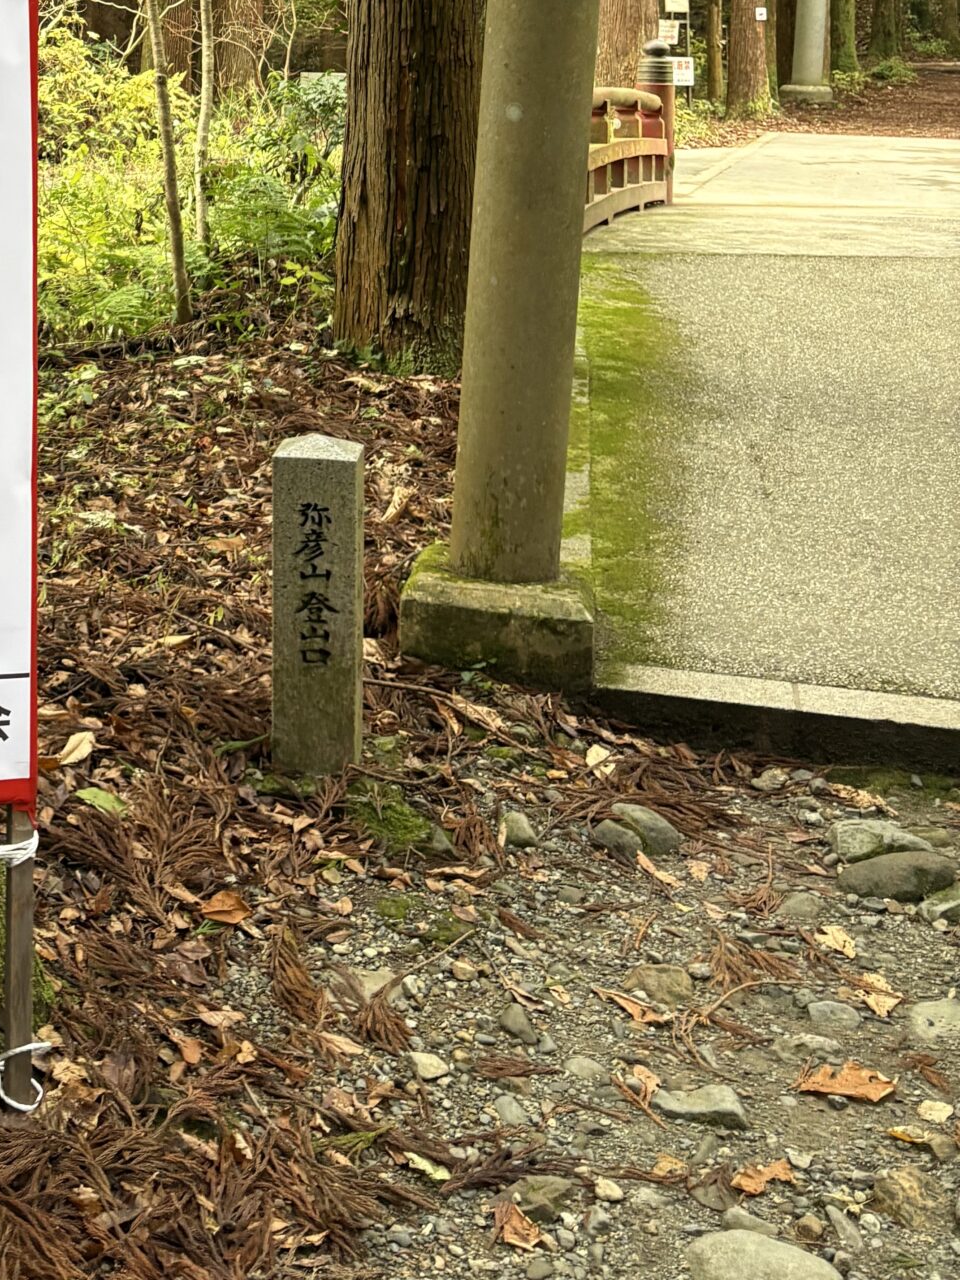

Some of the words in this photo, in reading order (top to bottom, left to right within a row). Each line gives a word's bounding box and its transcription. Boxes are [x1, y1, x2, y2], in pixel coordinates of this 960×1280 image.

[294, 502, 340, 665] 弥彦山登山口
